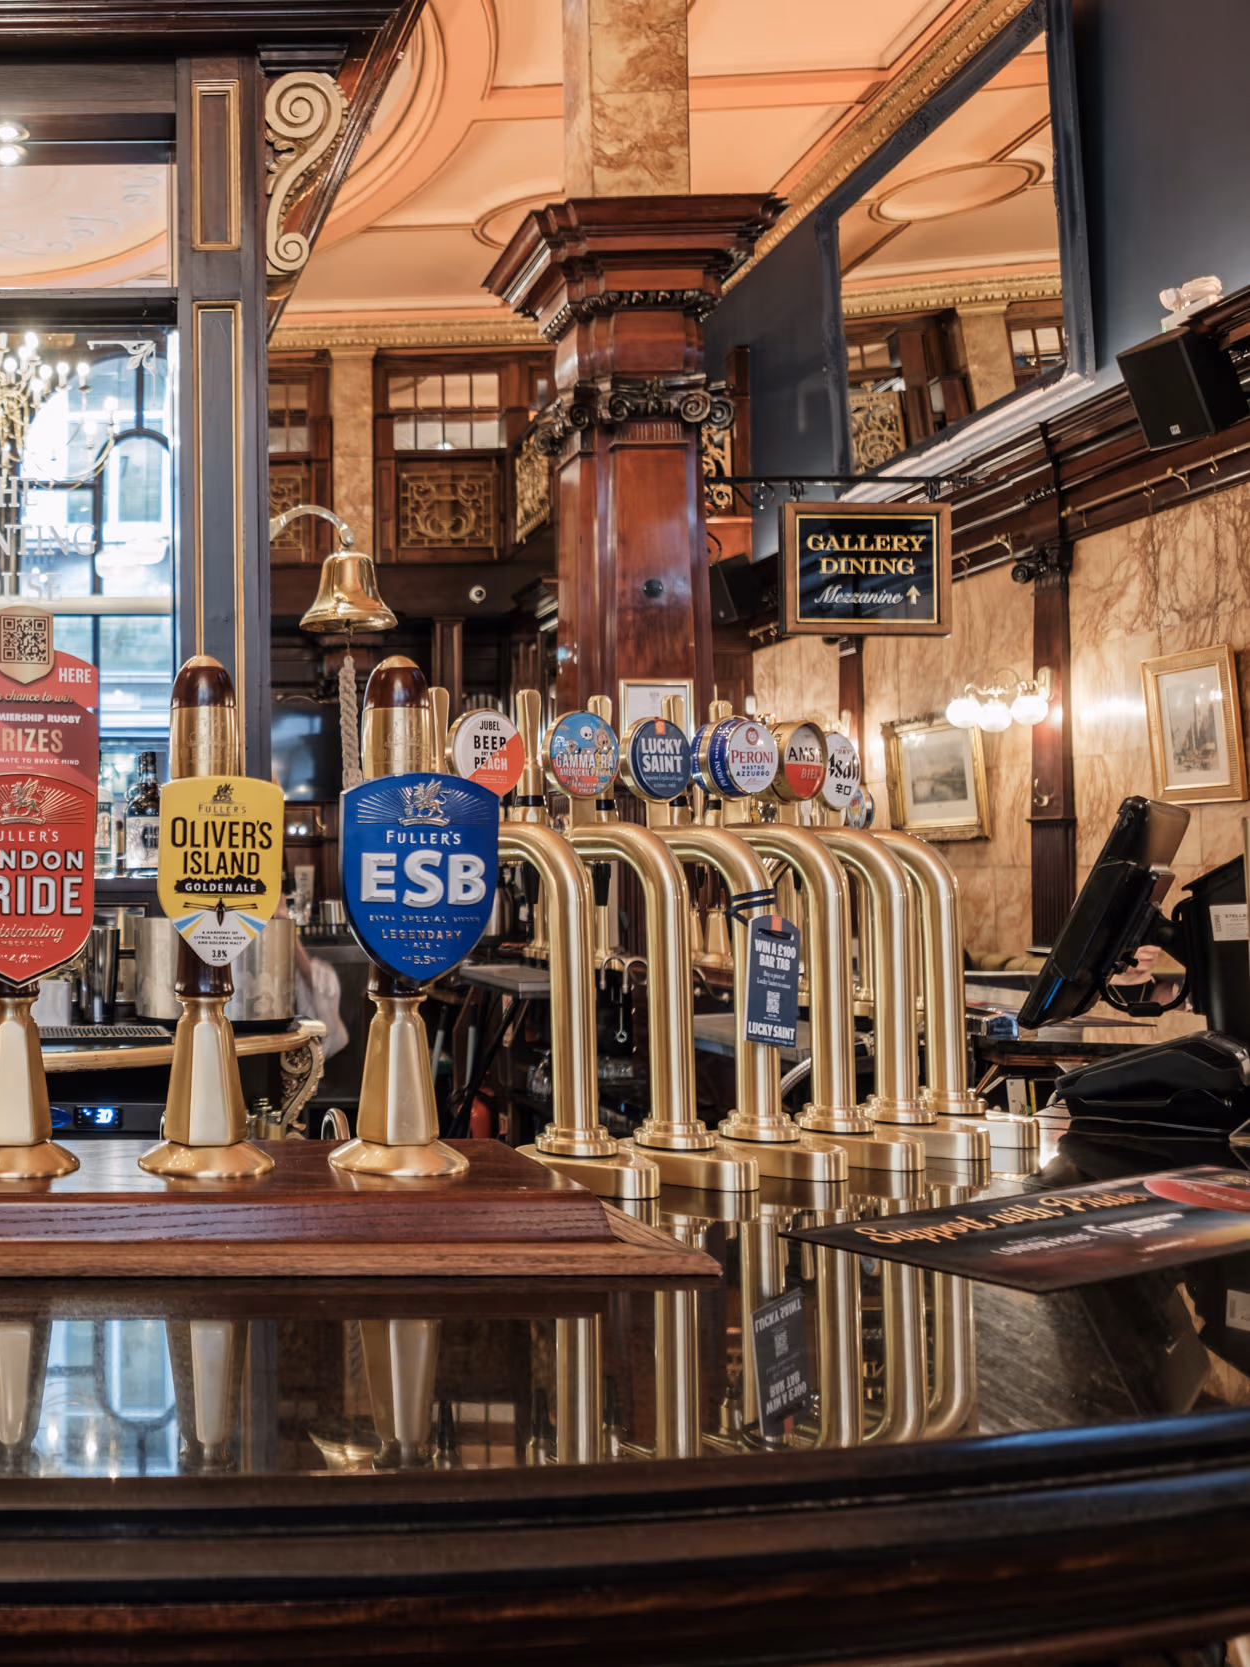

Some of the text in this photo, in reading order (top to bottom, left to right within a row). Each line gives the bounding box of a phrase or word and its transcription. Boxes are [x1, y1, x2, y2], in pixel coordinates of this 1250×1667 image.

[806, 534, 926, 552] GALLERY
[818, 557, 916, 575] DINING
[814, 584, 903, 604] Mezzanine
[58, 667, 92, 683] HERE
[5, 690, 40, 702] chance
[42, 691, 52, 702] to
[54, 695, 74, 703] win
[47, 714, 81, 724] RUGBY
[479, 720, 501, 731] JUBEL
[474, 735, 507, 751] BEER
[641, 737, 682, 754] LUCKY
[474, 757, 508, 771] PEACH
[556, 753, 618, 768] GAMMA RAY
[642, 755, 683, 773] SAINT
[731, 750, 773, 764] PERONI
[835, 783, 852, 796] 辛口
[171, 816, 273, 850] OLIVER'S
[386, 830, 462, 846] FULLER'S
[183, 851, 260, 875] ISLAND
[185, 882, 257, 892] GOLDEN ALE
[360, 850, 486, 908] ESB
[402, 915, 447, 923] SPECIAL
[381, 929, 462, 940] LEGENDARY
[28, 940, 45, 948] ALE
[755, 938, 796, 959] WIN A £100
[212, 950, 227, 958] 3.8%
[759, 954, 791, 971] BAR TAB
[748, 1021, 773, 1037] LUCKY
[773, 1025, 795, 1041] SAINT
[854, 1214, 997, 1244] Support
[987, 1204, 1064, 1224] with
[1038, 1191, 1147, 1212] Pride
